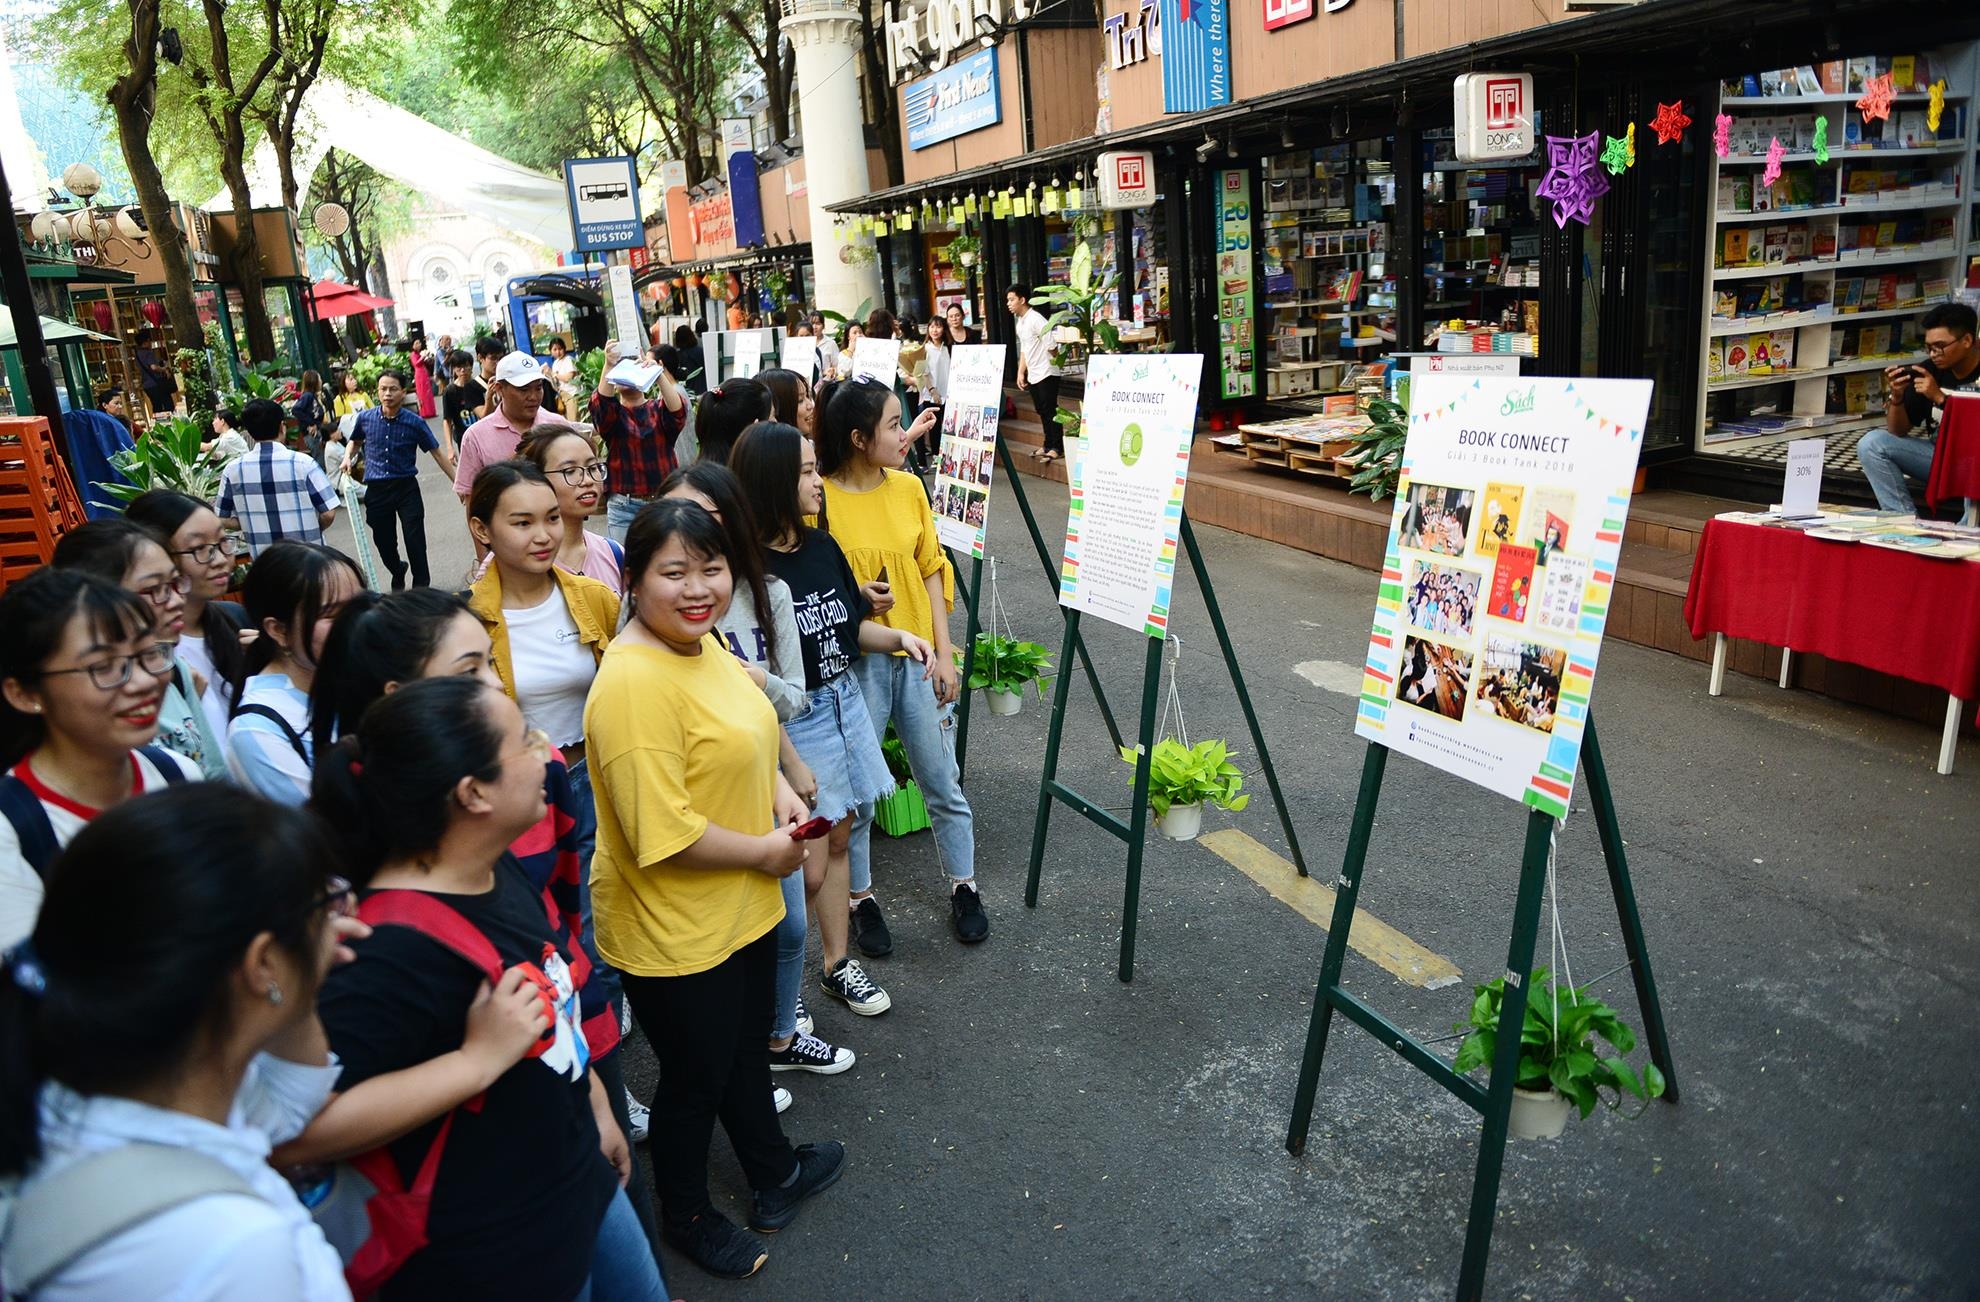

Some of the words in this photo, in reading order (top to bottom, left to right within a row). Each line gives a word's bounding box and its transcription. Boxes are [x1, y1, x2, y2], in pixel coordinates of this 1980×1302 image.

[1209, 46, 1224, 101] Where
[1224, 201, 1249, 222] 20
[587, 233, 608, 244] BUS
[609, 231, 634, 242] STOP
[1225, 231, 1250, 252] 50
[1111, 391, 1131, 403] BOOK
[1132, 392, 1165, 405] CONNECT
[1458, 429, 1497, 447] BOOK
[1500, 432, 1570, 454] CONNECT
[1472, 453, 1478, 463] 3
[1482, 454, 1507, 465] Book
[1544, 460, 1575, 473] 2018
[1796, 466, 1812, 477] 30%
[796, 605, 825, 636] OLDEST
[820, 598, 848, 627] CHILD
[818, 659, 832, 680] THE
